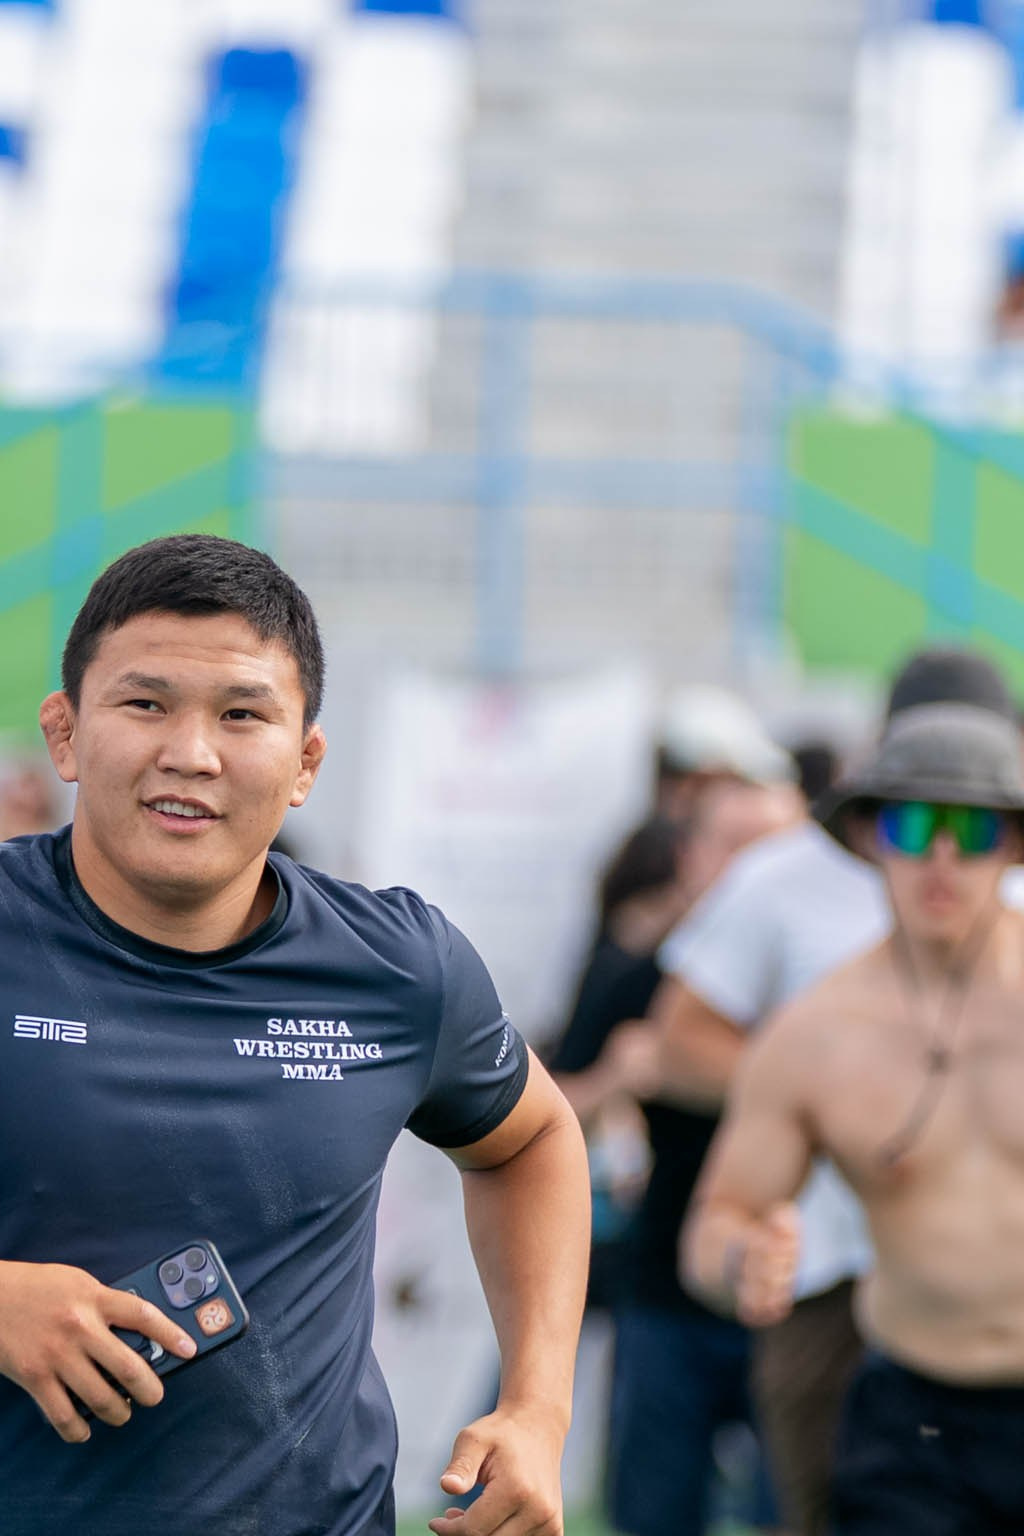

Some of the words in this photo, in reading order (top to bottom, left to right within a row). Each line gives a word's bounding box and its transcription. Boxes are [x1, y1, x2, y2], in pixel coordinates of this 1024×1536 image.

[266, 1018, 353, 1037] SAKHA
[233, 1038, 384, 1060] WRESTLING
[281, 1063, 344, 1081] MMA
